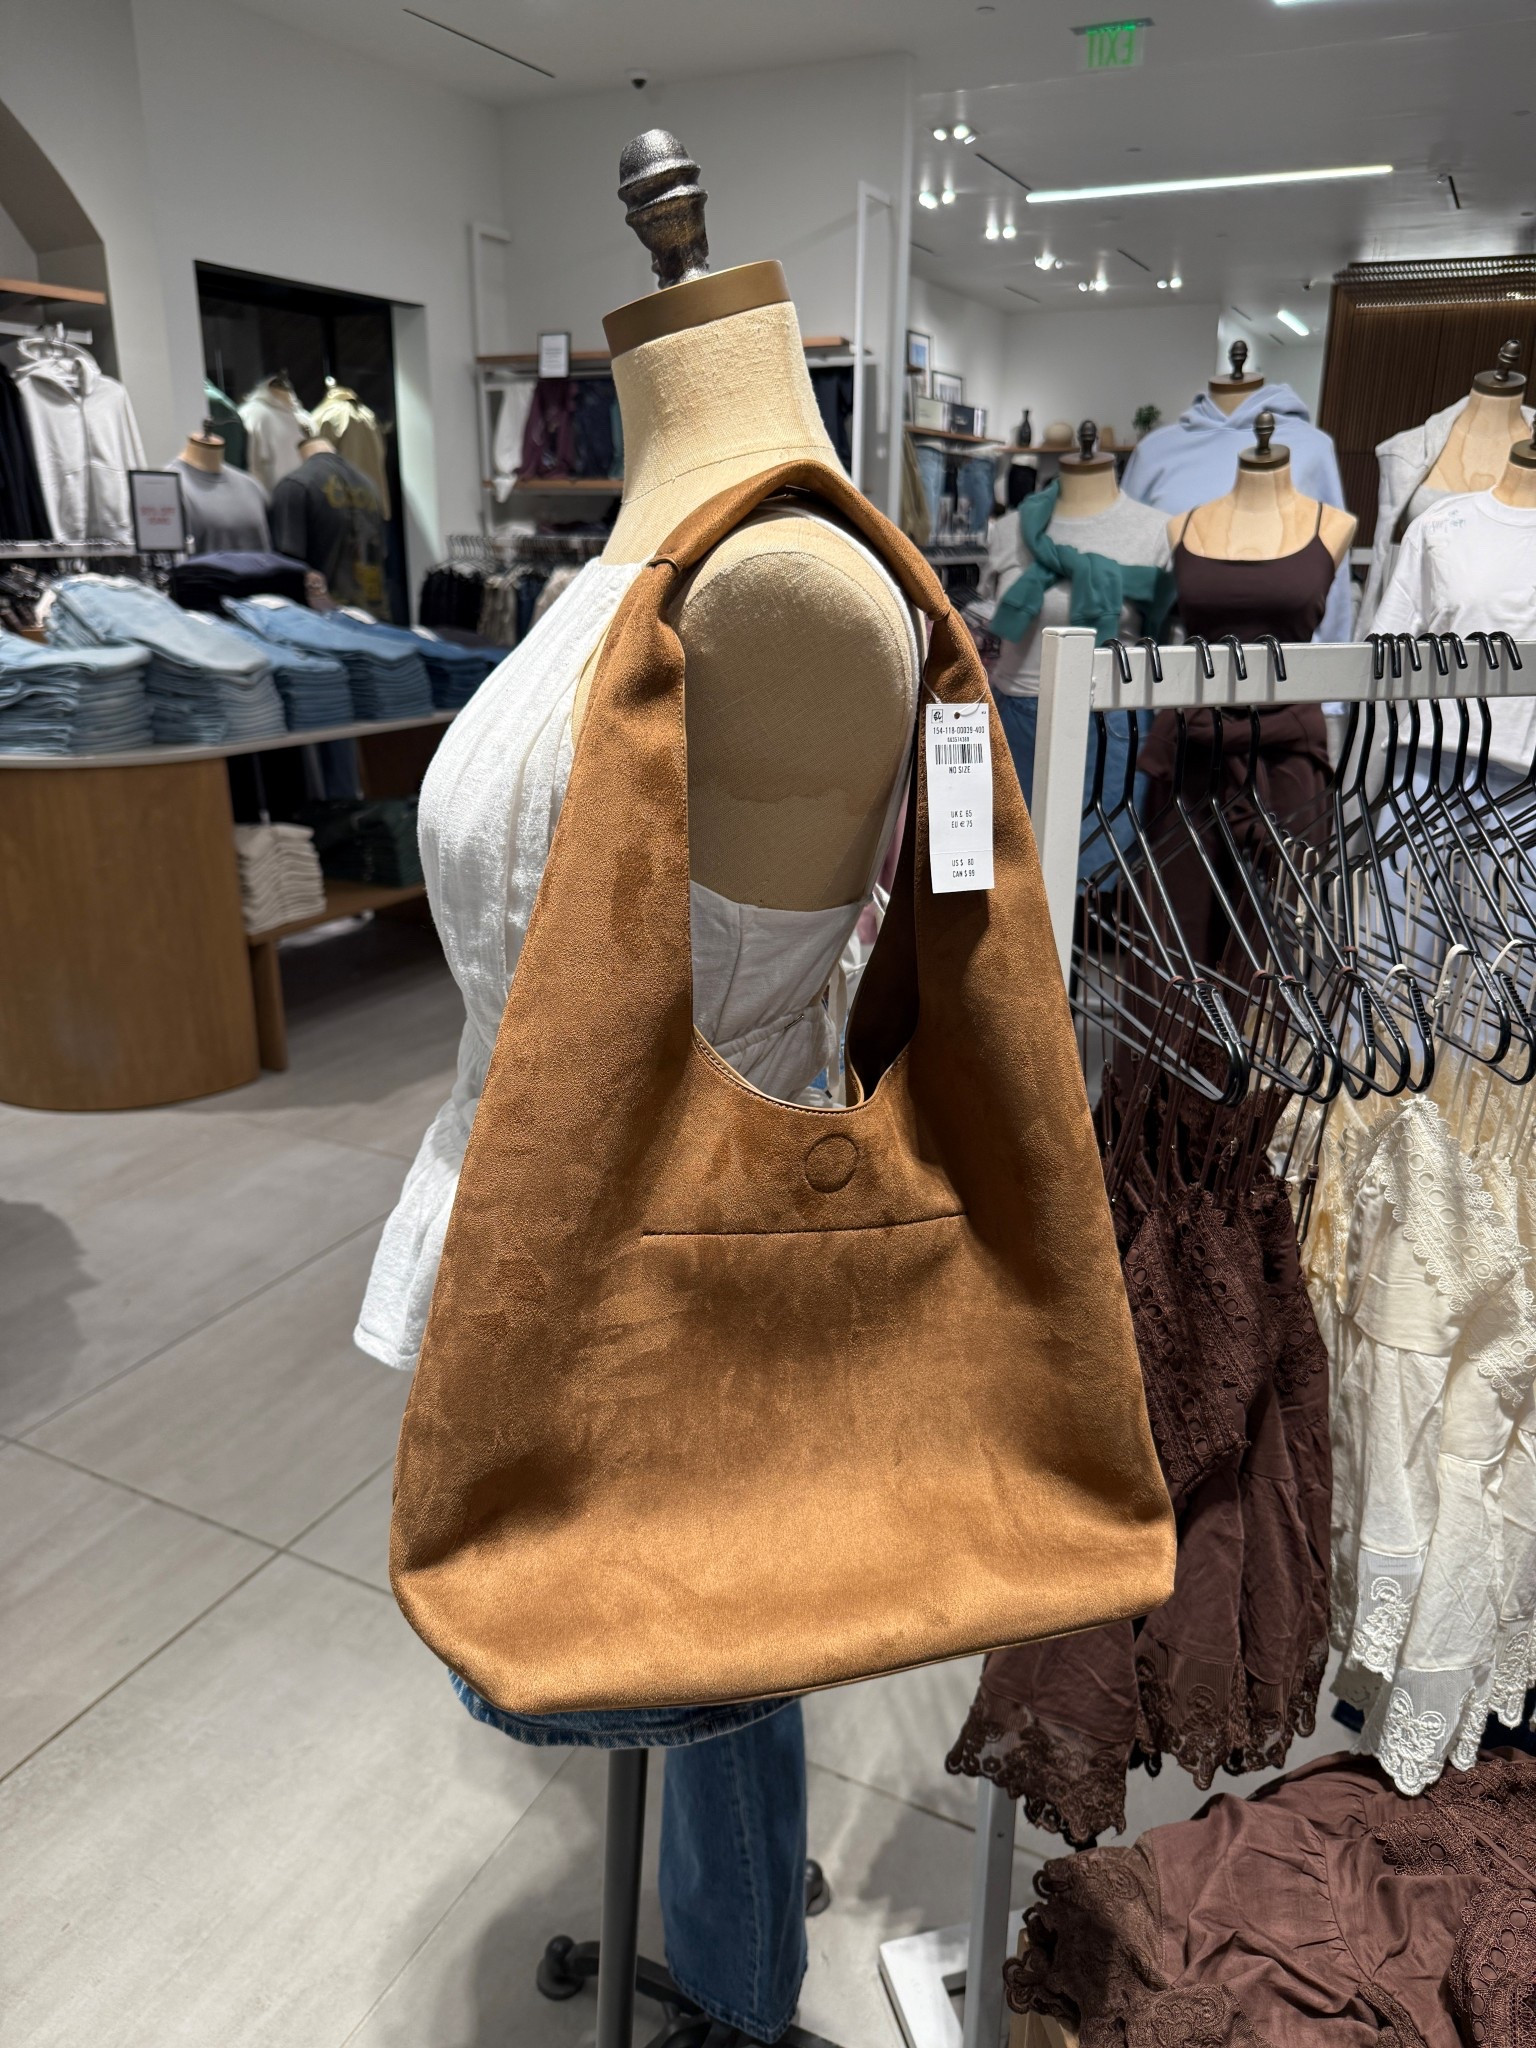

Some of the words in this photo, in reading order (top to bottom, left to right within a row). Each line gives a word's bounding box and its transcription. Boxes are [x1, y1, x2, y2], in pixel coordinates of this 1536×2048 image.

[949, 766, 957, 774] NO
[958, 765, 971, 774] SIZE
[965, 810, 973, 818] 65
[951, 821, 958, 829] EU
[966, 820, 973, 828] 75
[952, 859, 959, 867] US
[967, 858, 974, 866] 80
[952, 870, 963, 878] CAN
[968, 869, 975, 877] 99
